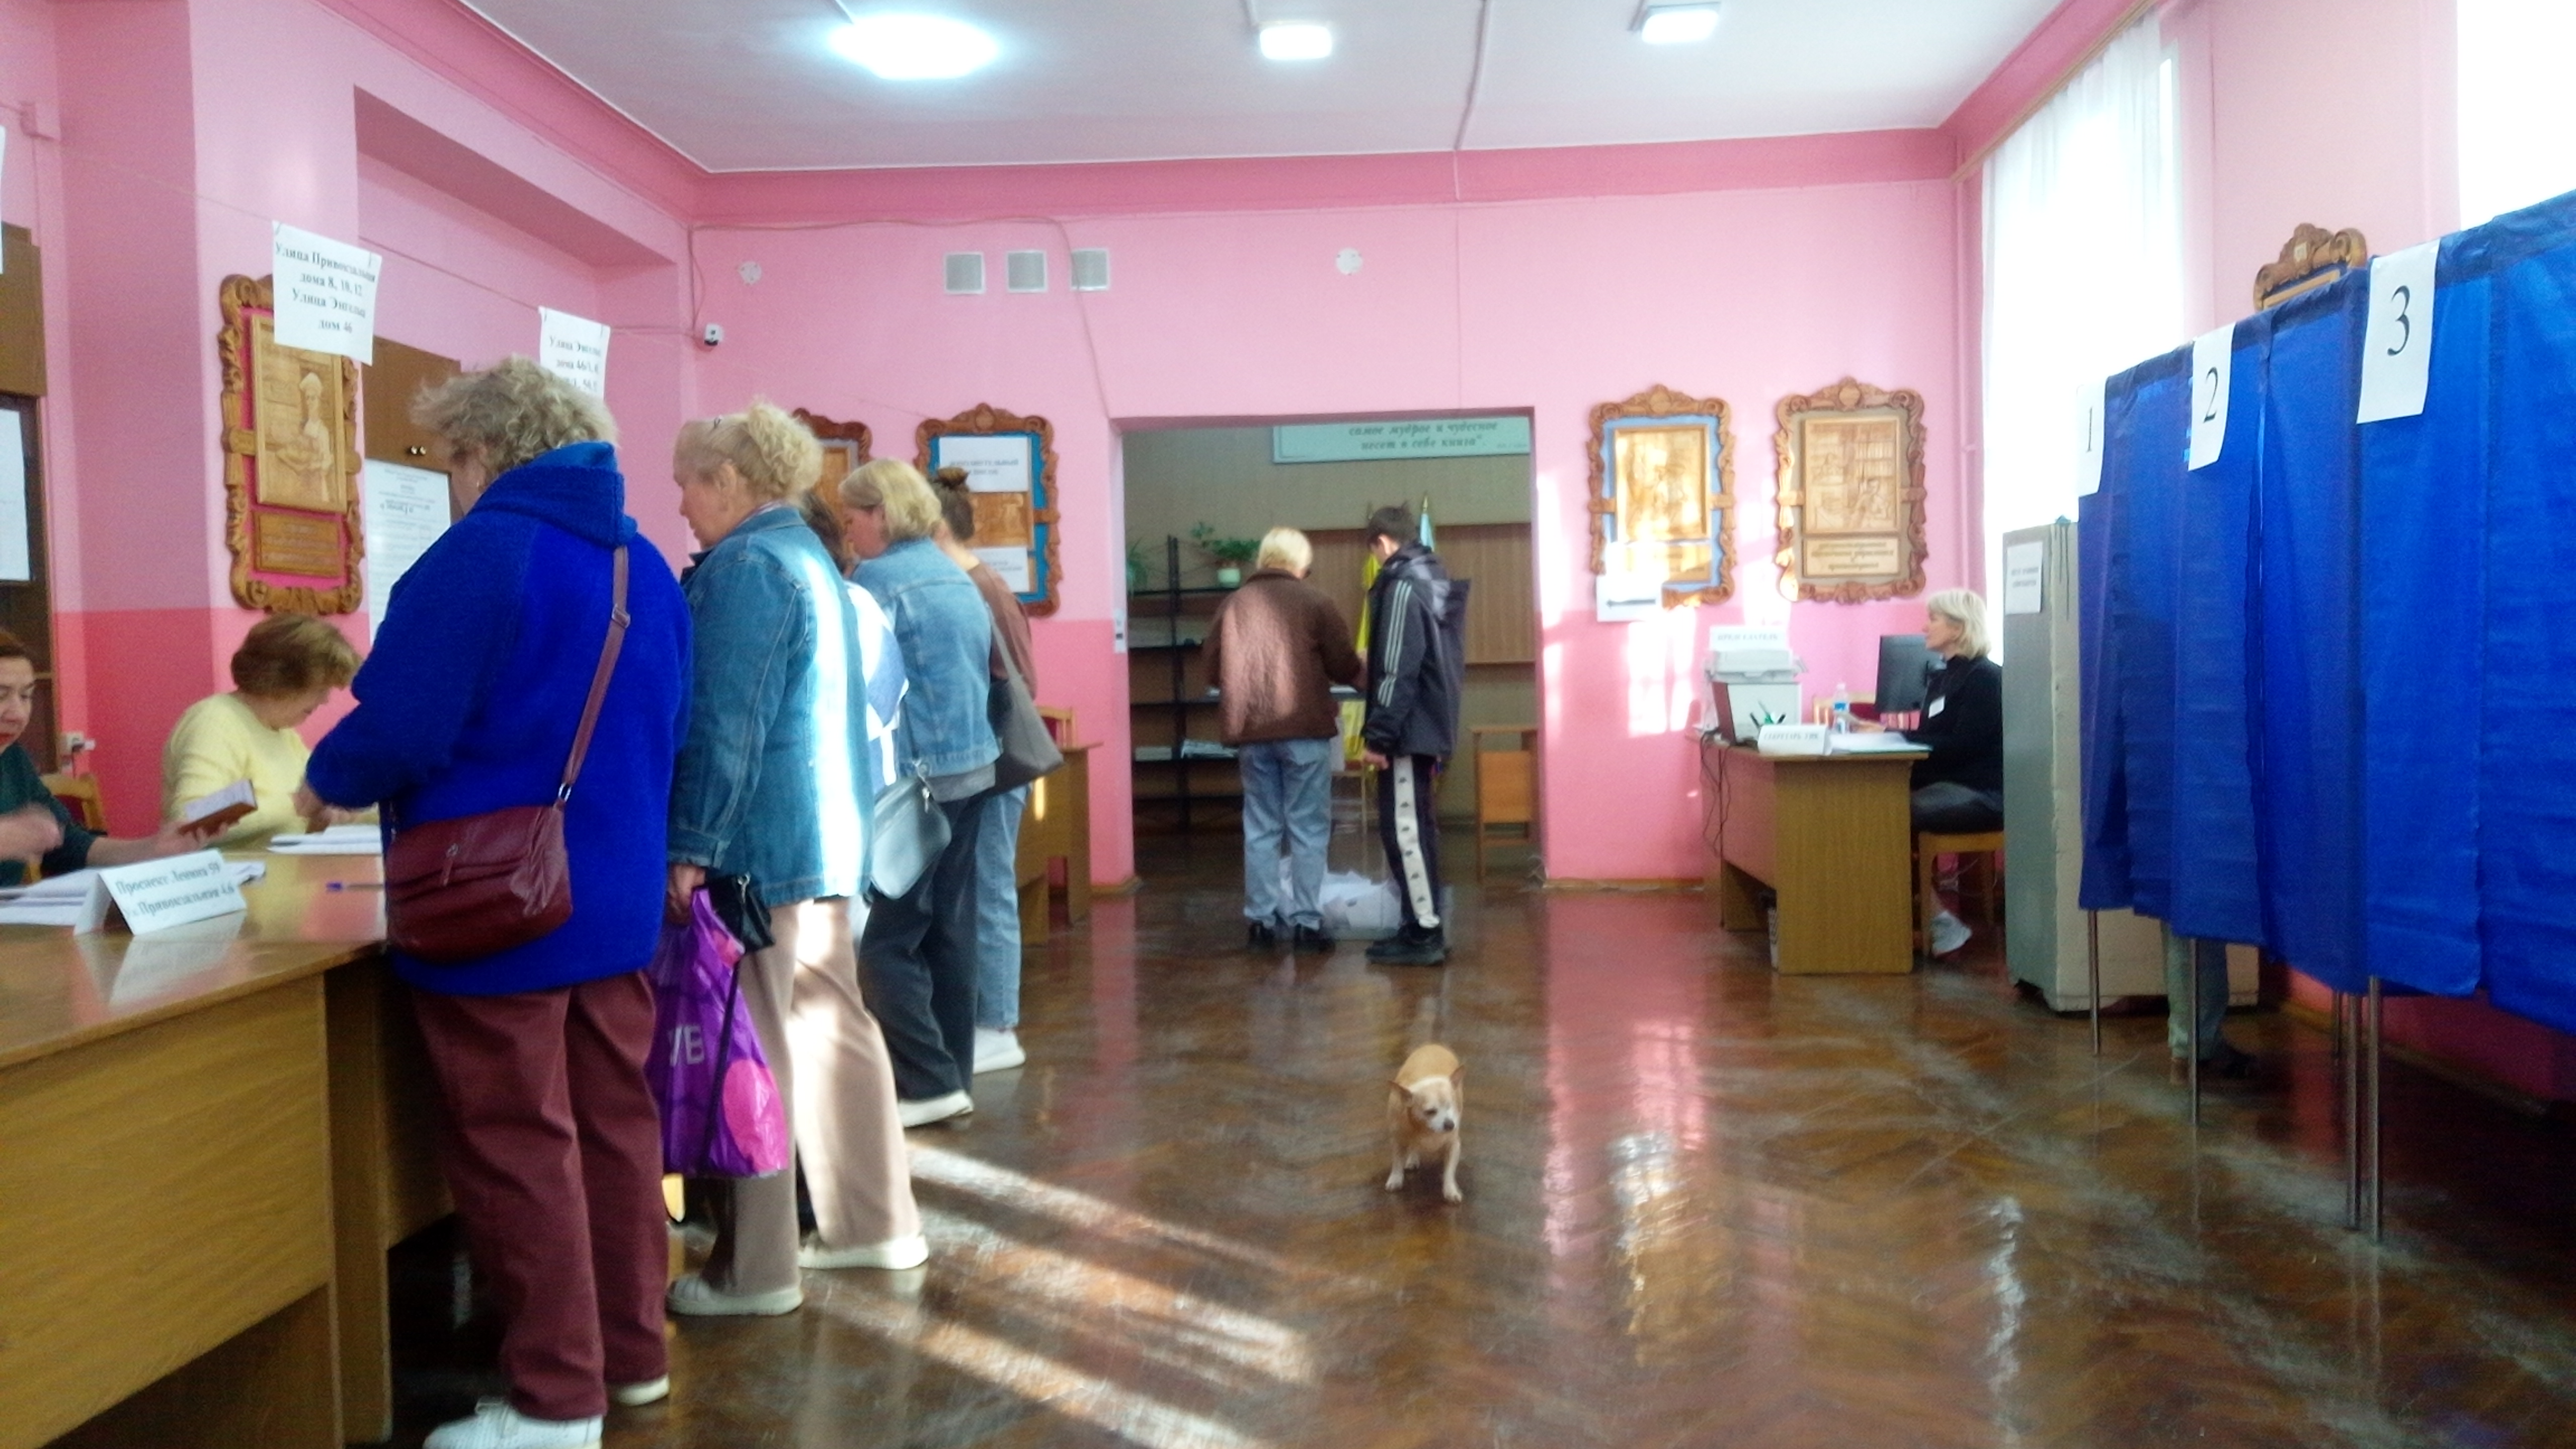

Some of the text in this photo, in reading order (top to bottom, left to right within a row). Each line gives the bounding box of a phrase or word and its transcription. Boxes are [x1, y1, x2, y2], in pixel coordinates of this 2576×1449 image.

[292, 287, 326, 307] Улица
[2387, 285, 2410, 356] 3
[2203, 366, 2219, 424] 2
[2086, 406, 2093, 453] 1
